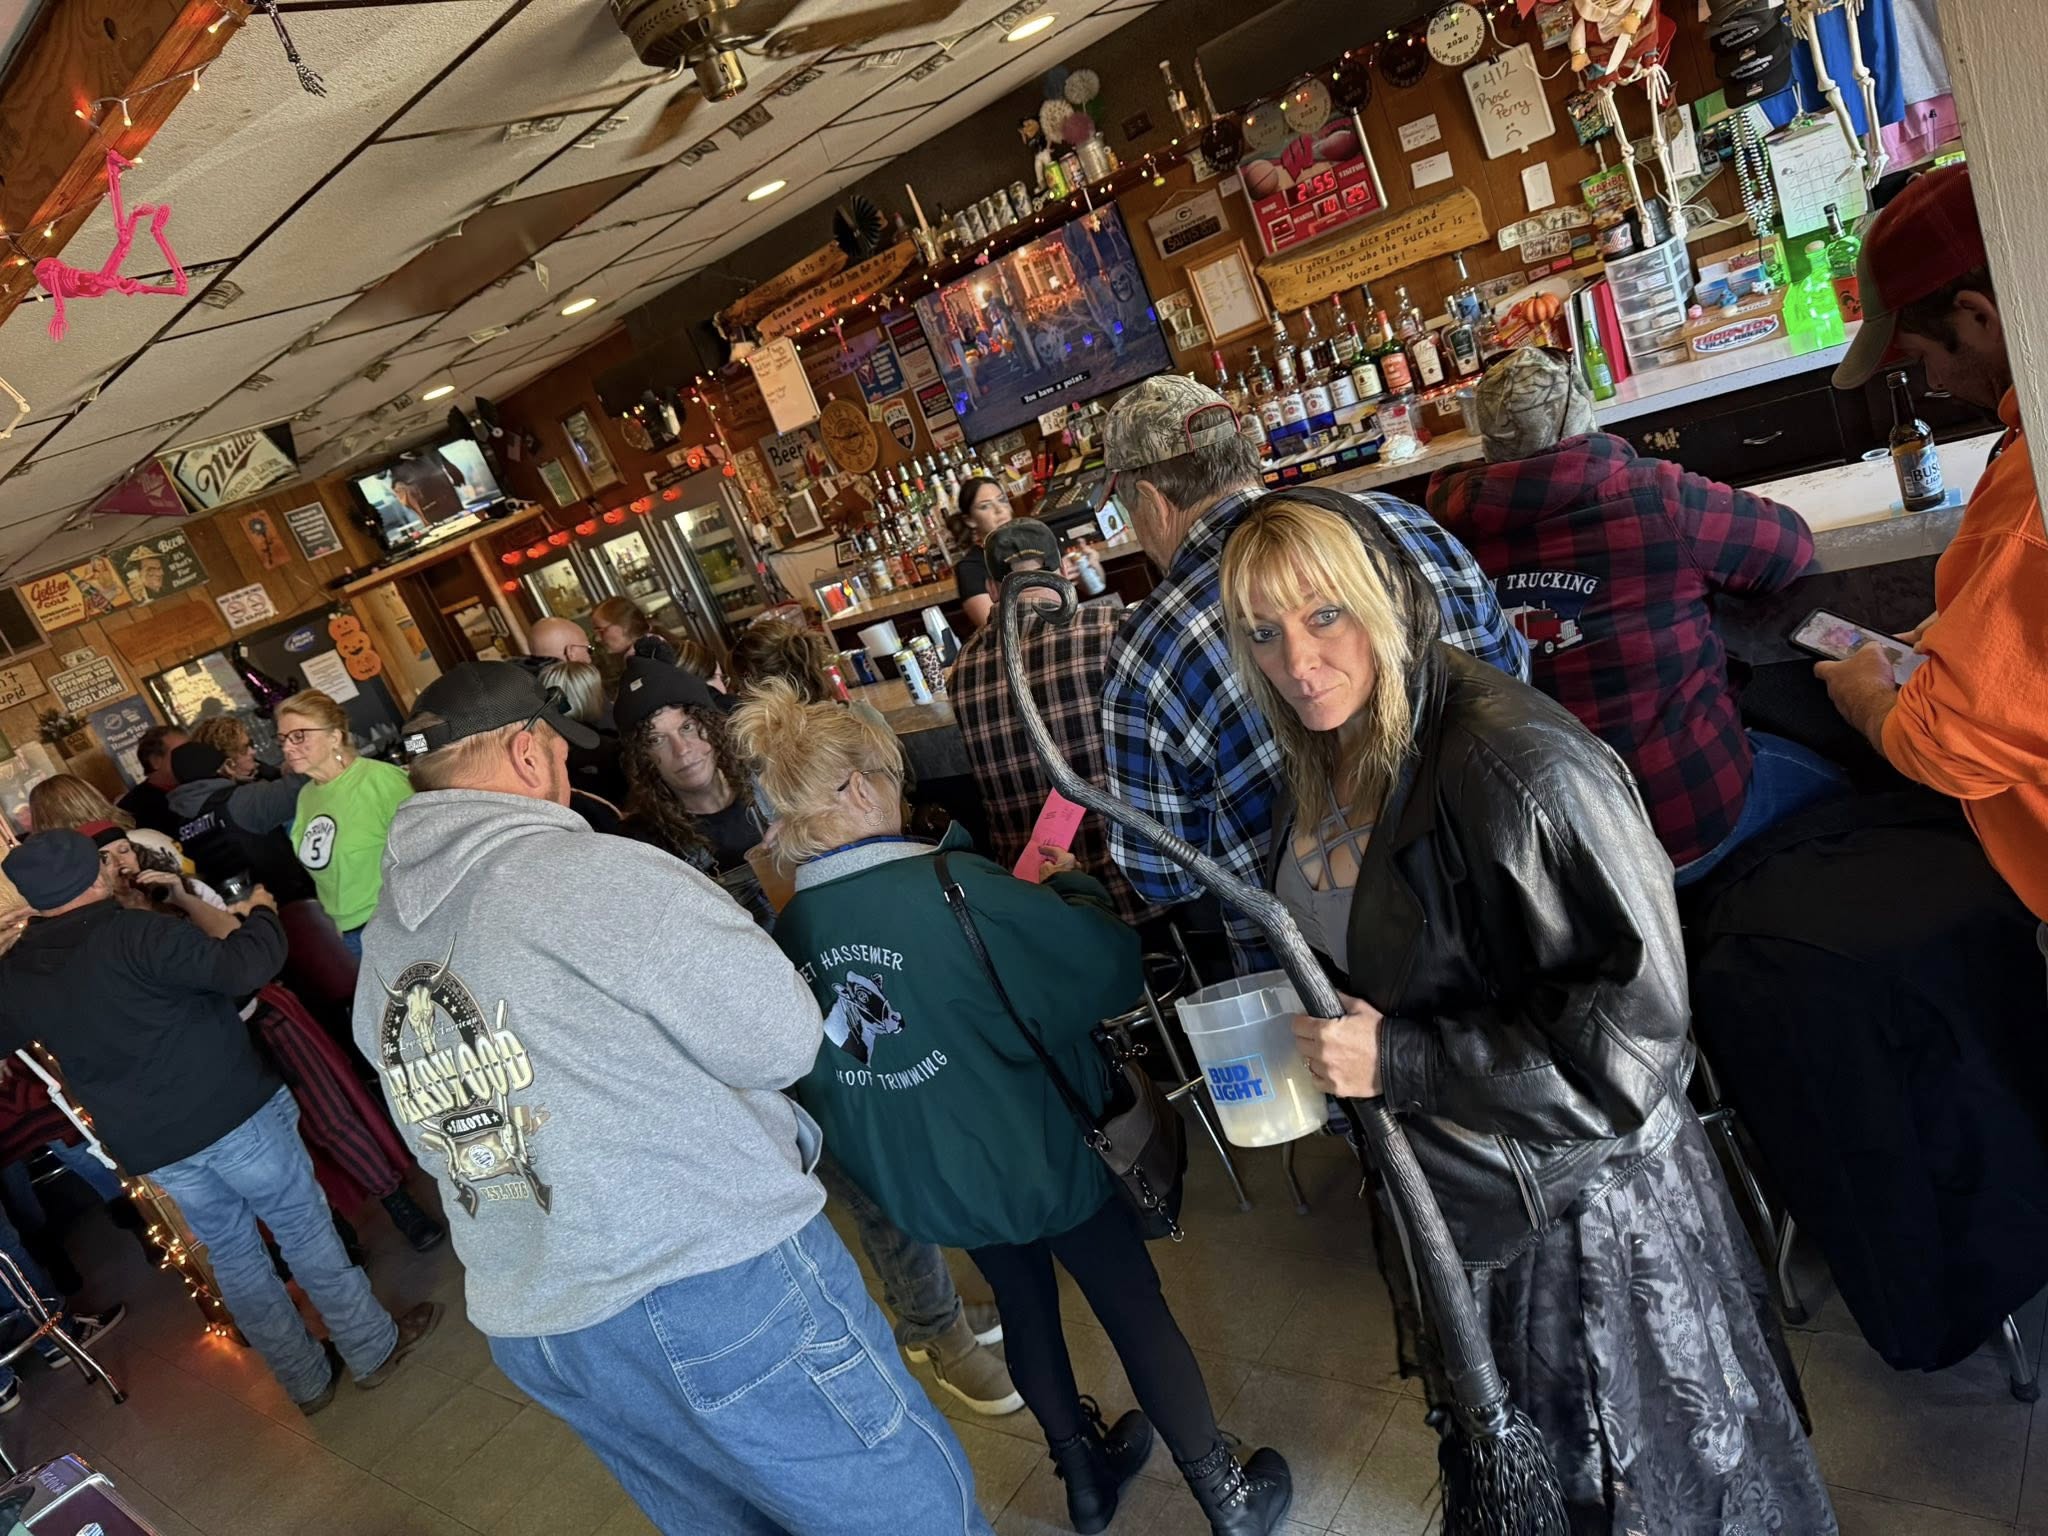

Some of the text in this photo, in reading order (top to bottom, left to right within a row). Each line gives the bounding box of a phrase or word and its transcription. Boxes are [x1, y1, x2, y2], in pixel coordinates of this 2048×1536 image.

[1446, 35, 1469, 49] 2020
[1490, 100, 1532, 118] Perry
[1347, 186, 1366, 203] 25
[1588, 174, 1625, 196] HARIBO
[1360, 236, 1379, 248] dice
[1384, 223, 1411, 239] game
[1418, 209, 1437, 225] and
[1330, 260, 1353, 275] know
[1359, 251, 1377, 263] who
[1381, 243, 1396, 255] the
[1696, 319, 1775, 346] THORNTON
[1704, 338, 1733, 350] TRAIL
[1024, 395, 1037, 403] You
[1038, 387, 1054, 397] have
[1064, 374, 1087, 389] point.
[196, 431, 260, 500] Miller
[767, 444, 804, 466] Beer
[1507, 572, 1597, 594] TRUCKING
[44, 597, 69, 608] COLA
[56, 666, 112, 691] OFFENDS YOU
[67, 683, 122, 712] GOOD LAUGH
[179, 811, 215, 841] SECURITY
[311, 836, 321, 861] 5
[820, 944, 904, 970] HASSEMER
[437, 1016, 478, 1036] American
[877, 1050, 947, 1090] TRIMMING
[1207, 1063, 1250, 1084] BUD
[1209, 1077, 1263, 1101] LIGHT
